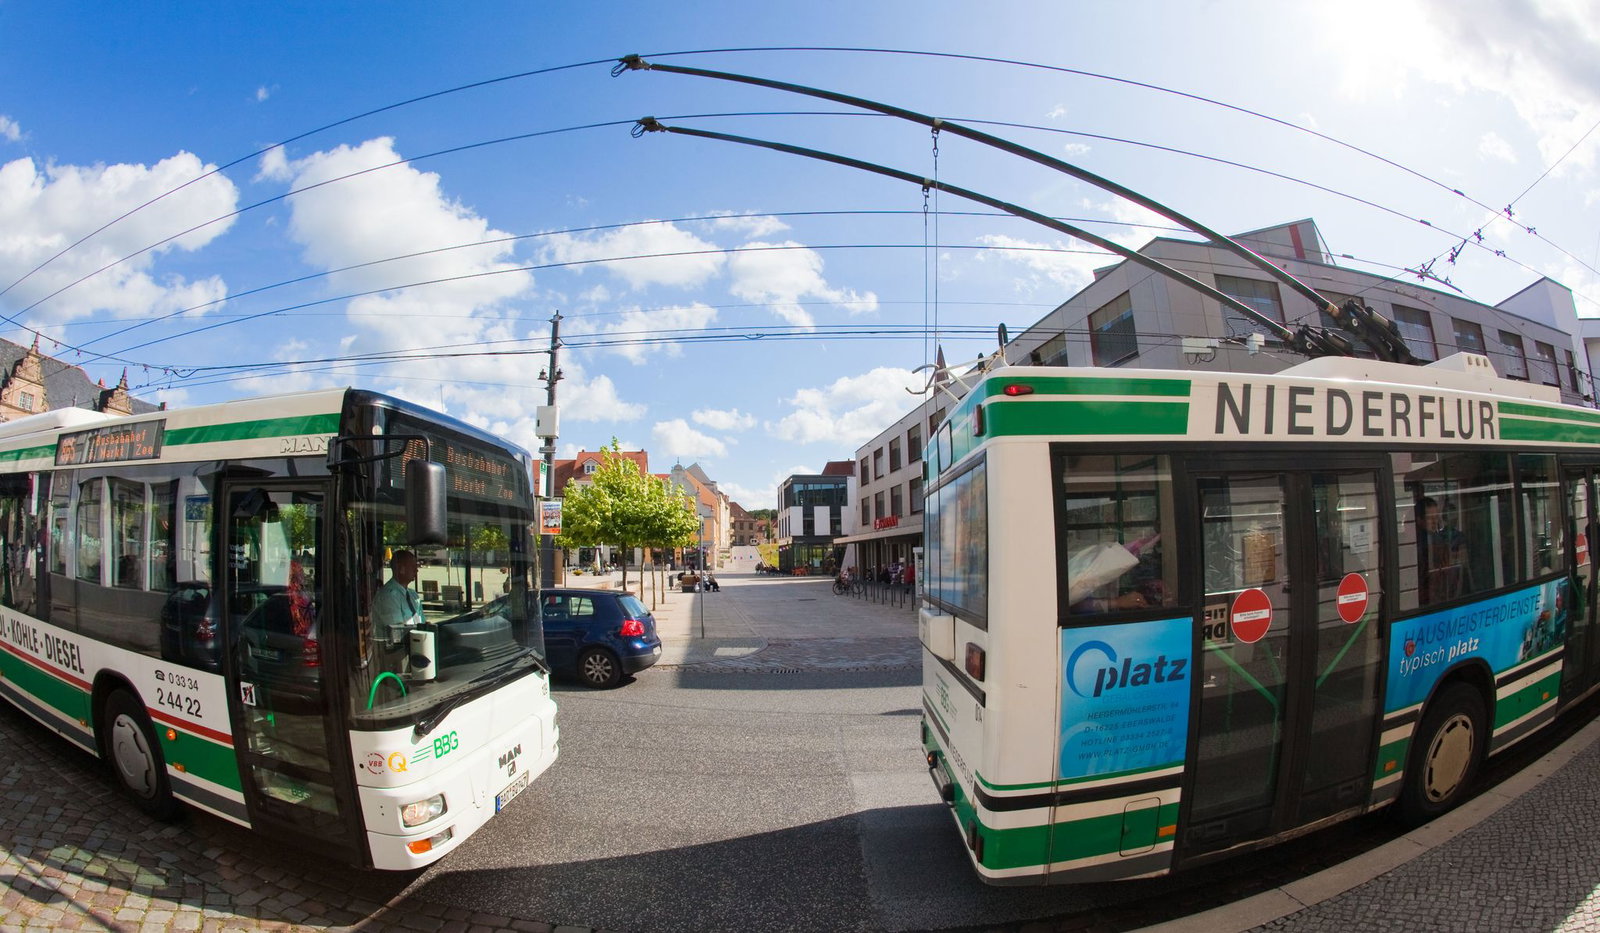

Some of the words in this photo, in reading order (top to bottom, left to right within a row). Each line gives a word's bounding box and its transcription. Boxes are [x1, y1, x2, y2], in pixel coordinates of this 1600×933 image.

[1215, 381, 1496, 440] NIEDERFLUR
[280, 436, 330, 453] MAN
[447, 446, 508, 477] Busbahnhof
[454, 475, 486, 495] Markt
[1403, 593, 1542, 651] HAUSMEISTERDIENSTE
[11, 618, 39, 654] KOHLE
[44, 633, 85, 675] DIESEL
[1400, 645, 1446, 678] typisch
[1448, 637, 1480, 662] platz
[1093, 655, 1188, 698] platz
[433, 730, 459, 759] BBG
[498, 743, 522, 769] MAN
